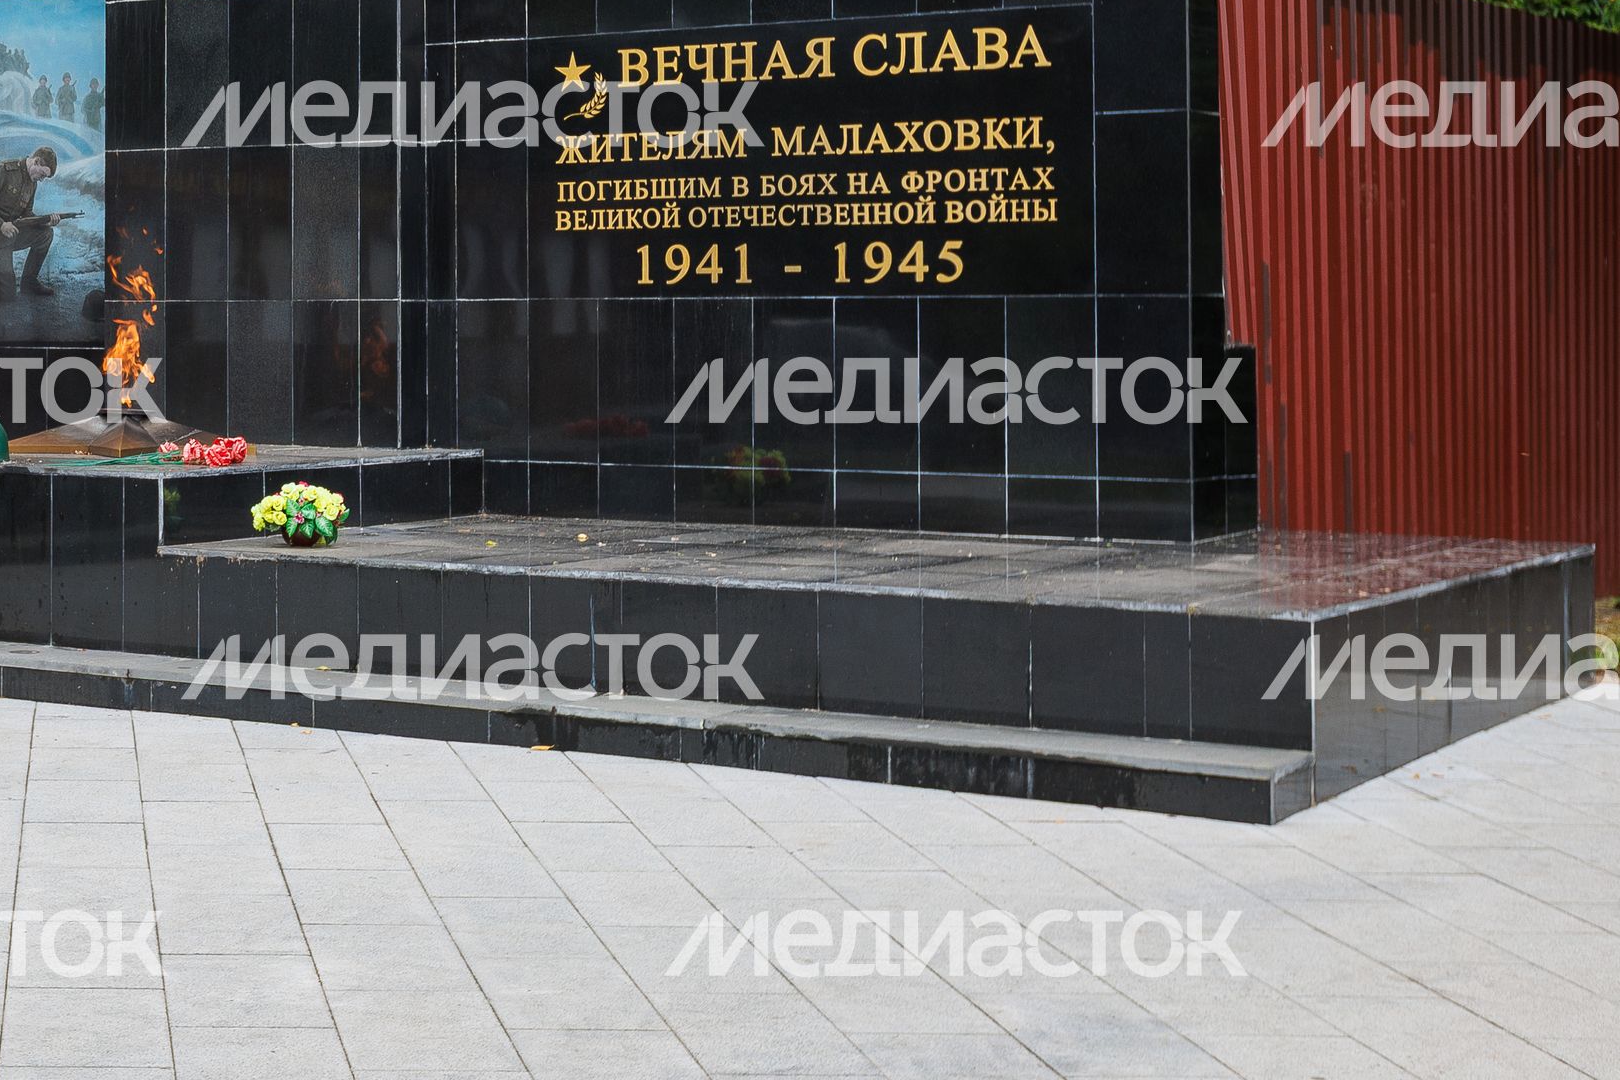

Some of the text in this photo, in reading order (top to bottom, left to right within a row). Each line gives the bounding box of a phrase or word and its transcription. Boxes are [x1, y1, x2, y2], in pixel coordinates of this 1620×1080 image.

[618, 24, 1052, 88] ВЕЧНАЯ СЛАВА
[555, 116, 1056, 165] ЖИТЕЛЯМ МАЛАХОВКИ,
[557, 167, 1056, 203] ПОГИБШИМ В БОЯХ НА ФРОНТАХ
[555, 191, 1058, 231] ВЕЛИКОЙ ОТЕЧЕСТВЕННОЙ ВОЙНЫ
[636, 243, 753, 285] 1941
[834, 239, 965, 283] 1945
